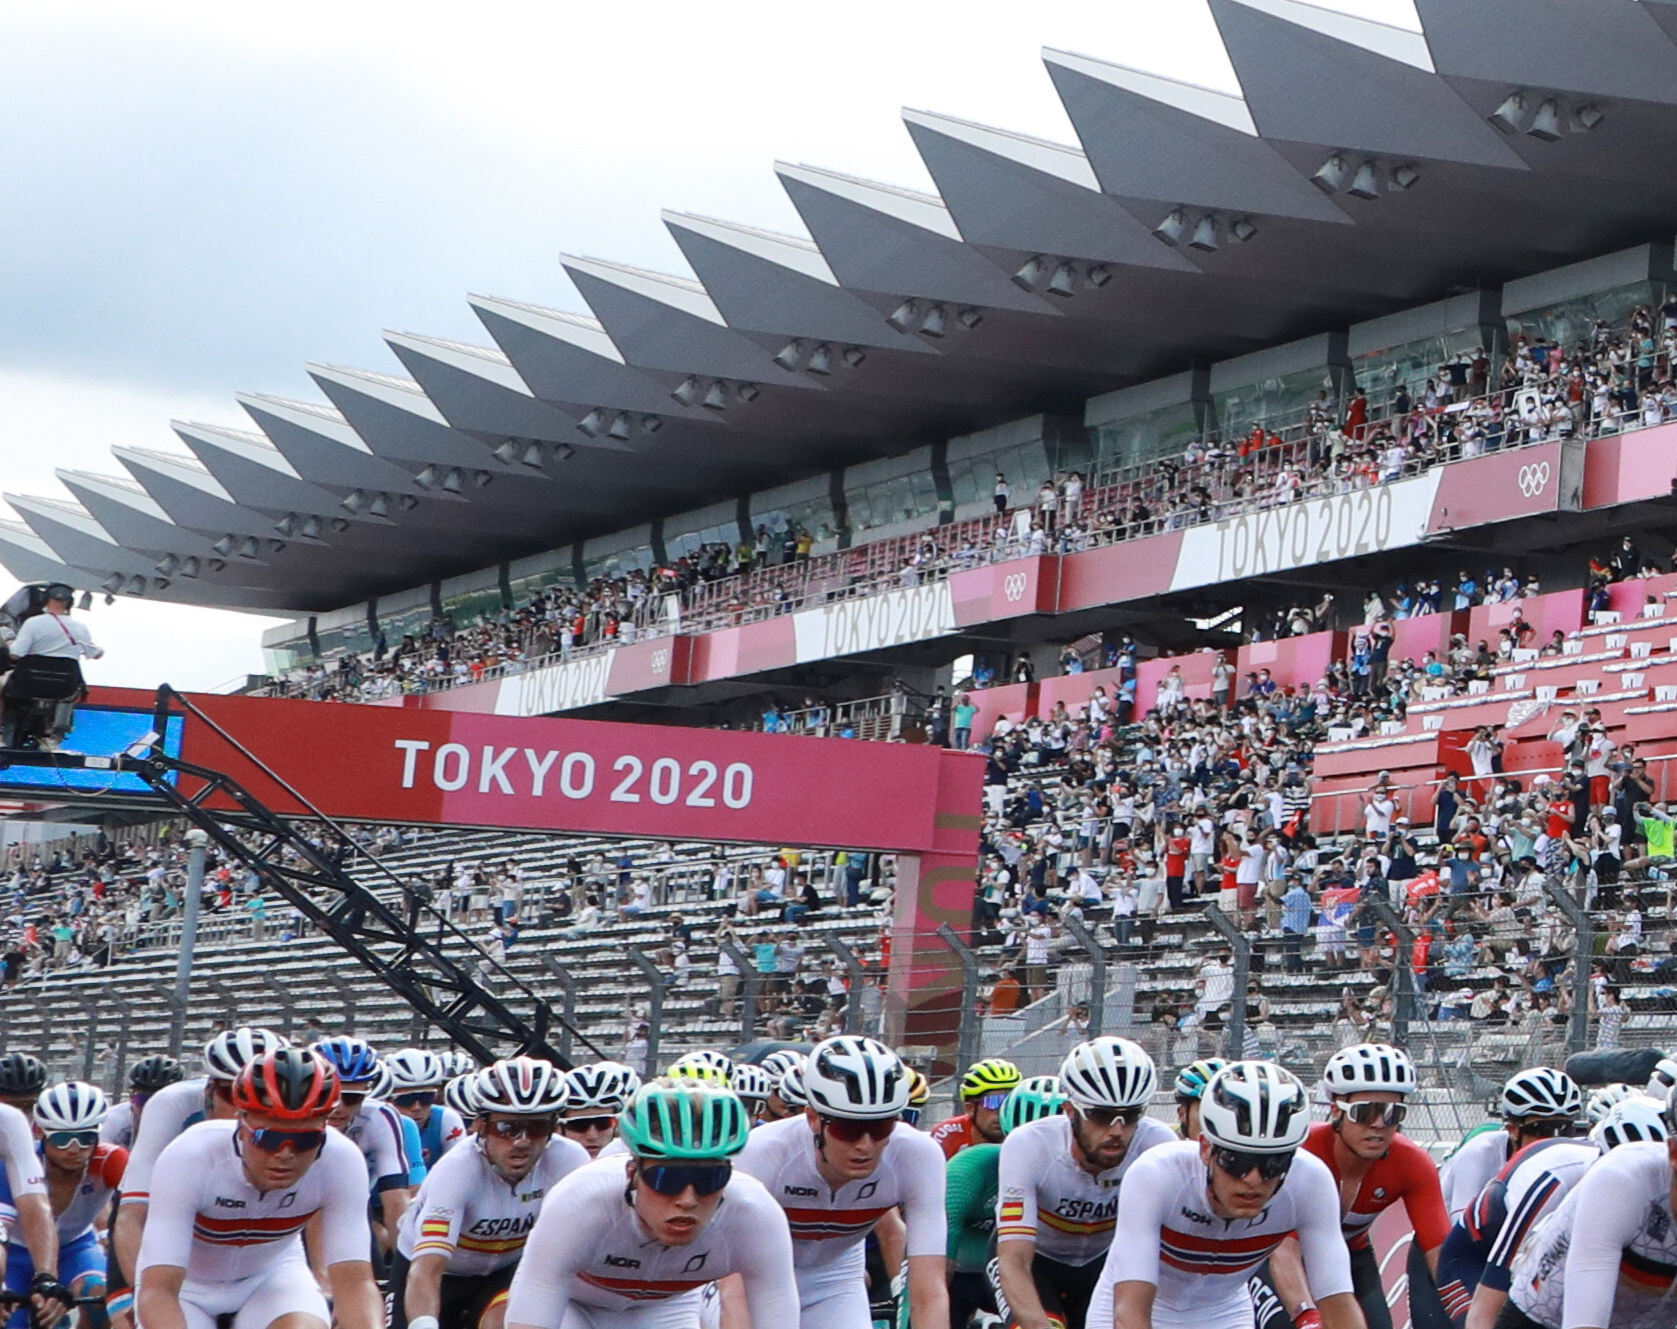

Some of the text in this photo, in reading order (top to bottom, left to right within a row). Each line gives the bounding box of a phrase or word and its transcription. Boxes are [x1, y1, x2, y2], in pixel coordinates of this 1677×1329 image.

[1216, 485, 1392, 582] TOKYO 2020
[821, 580, 949, 657] TOKYO 2020
[519, 670, 568, 716] TOKYO
[394, 739, 753, 811] TOKYO 2020
[933, 1122, 964, 1143] TUGAL
[214, 1195, 246, 1209] NOR
[784, 1184, 819, 1198] NOR
[471, 1212, 534, 1236] ESPAÑ
[604, 1254, 641, 1270] NOR
